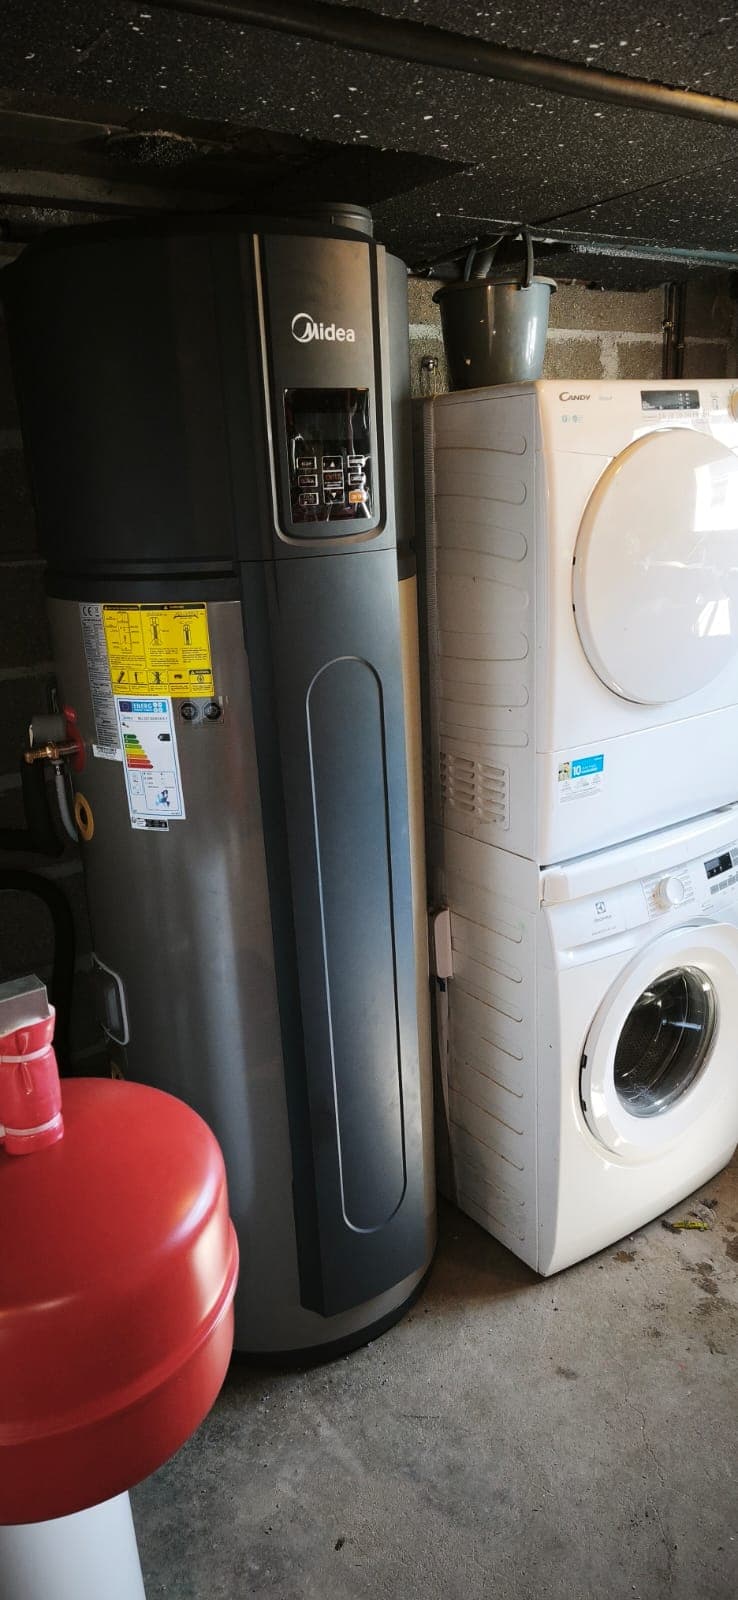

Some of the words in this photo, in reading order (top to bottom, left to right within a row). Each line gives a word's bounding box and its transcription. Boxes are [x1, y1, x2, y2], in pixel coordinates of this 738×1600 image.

[291, 312, 356, 343] Midea
[559, 391, 591, 402] CANDY
[573, 765, 582, 776] 10
